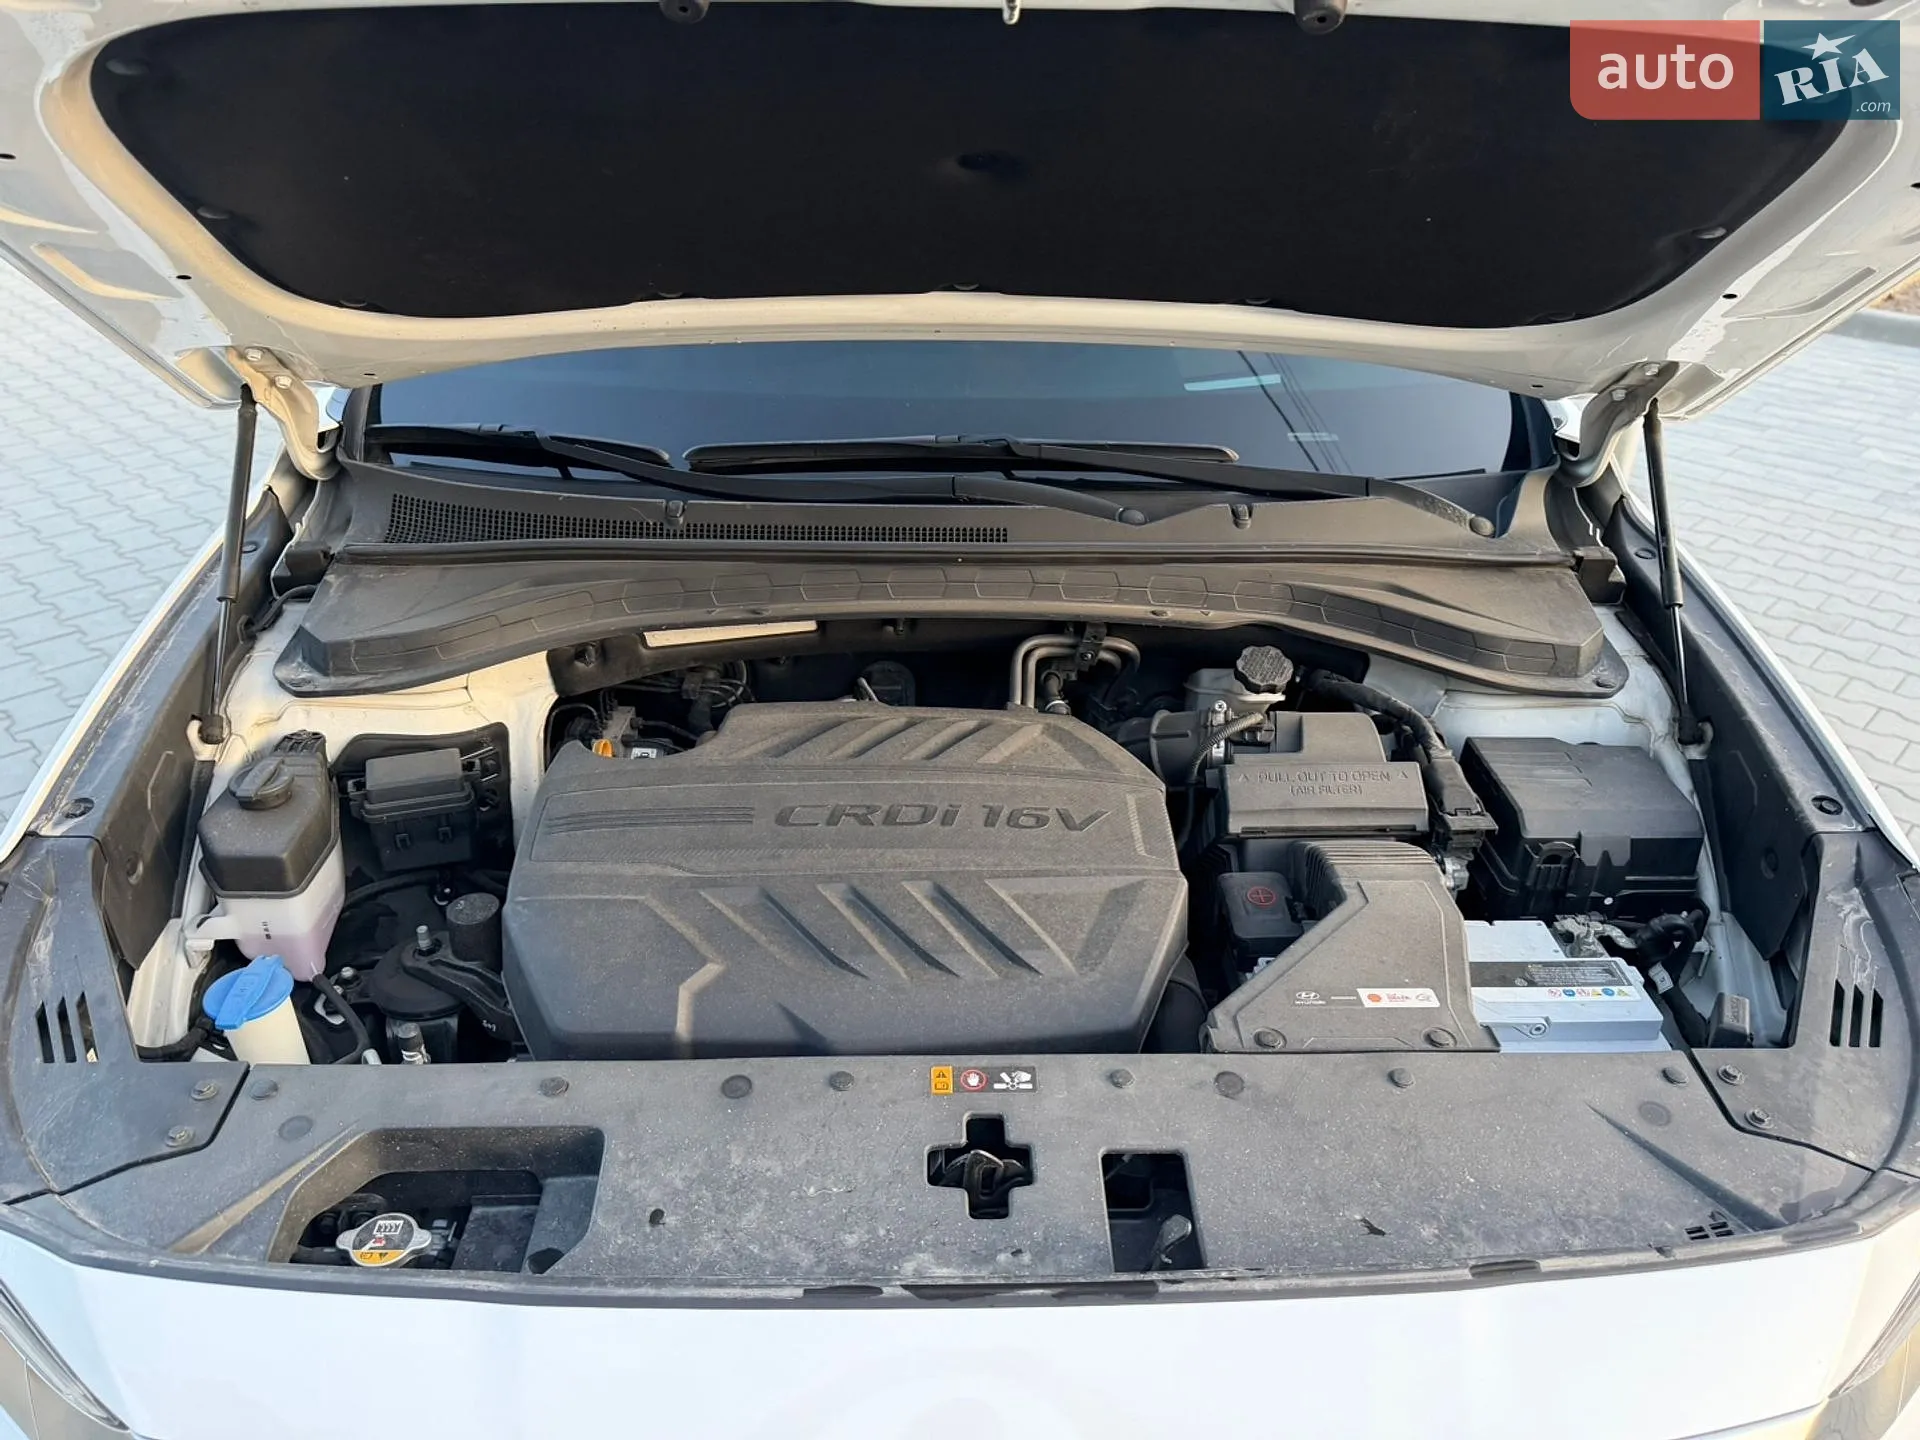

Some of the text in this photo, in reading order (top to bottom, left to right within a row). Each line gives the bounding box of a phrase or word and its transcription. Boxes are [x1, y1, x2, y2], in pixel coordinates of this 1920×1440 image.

[1258, 770, 1391, 783] PULL OUT TO OPEN
[774, 803, 1112, 832] CRDi 16V
